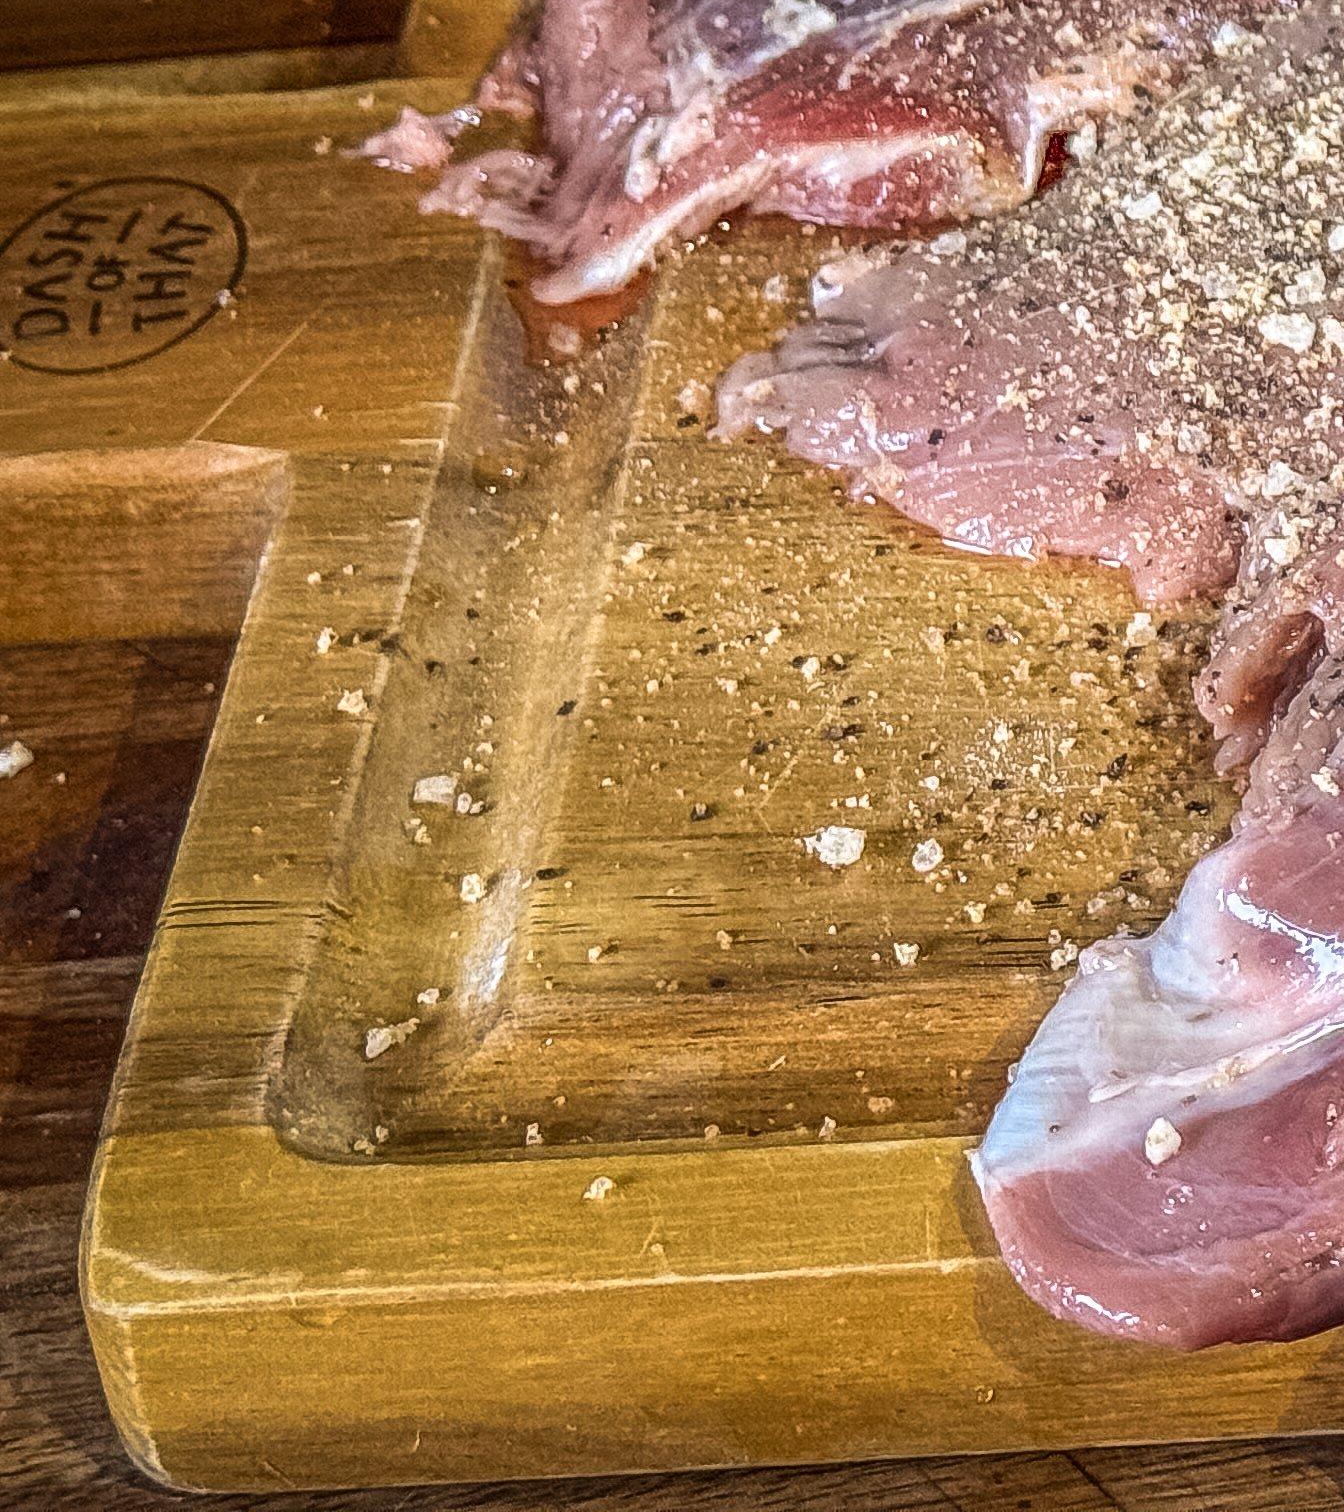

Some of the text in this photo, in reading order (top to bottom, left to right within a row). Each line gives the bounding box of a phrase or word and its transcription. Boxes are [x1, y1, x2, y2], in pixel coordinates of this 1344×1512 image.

[12, 210, 109, 338] DASH
[87, 255, 130, 291] OF
[132, 212, 214, 333] THAT
